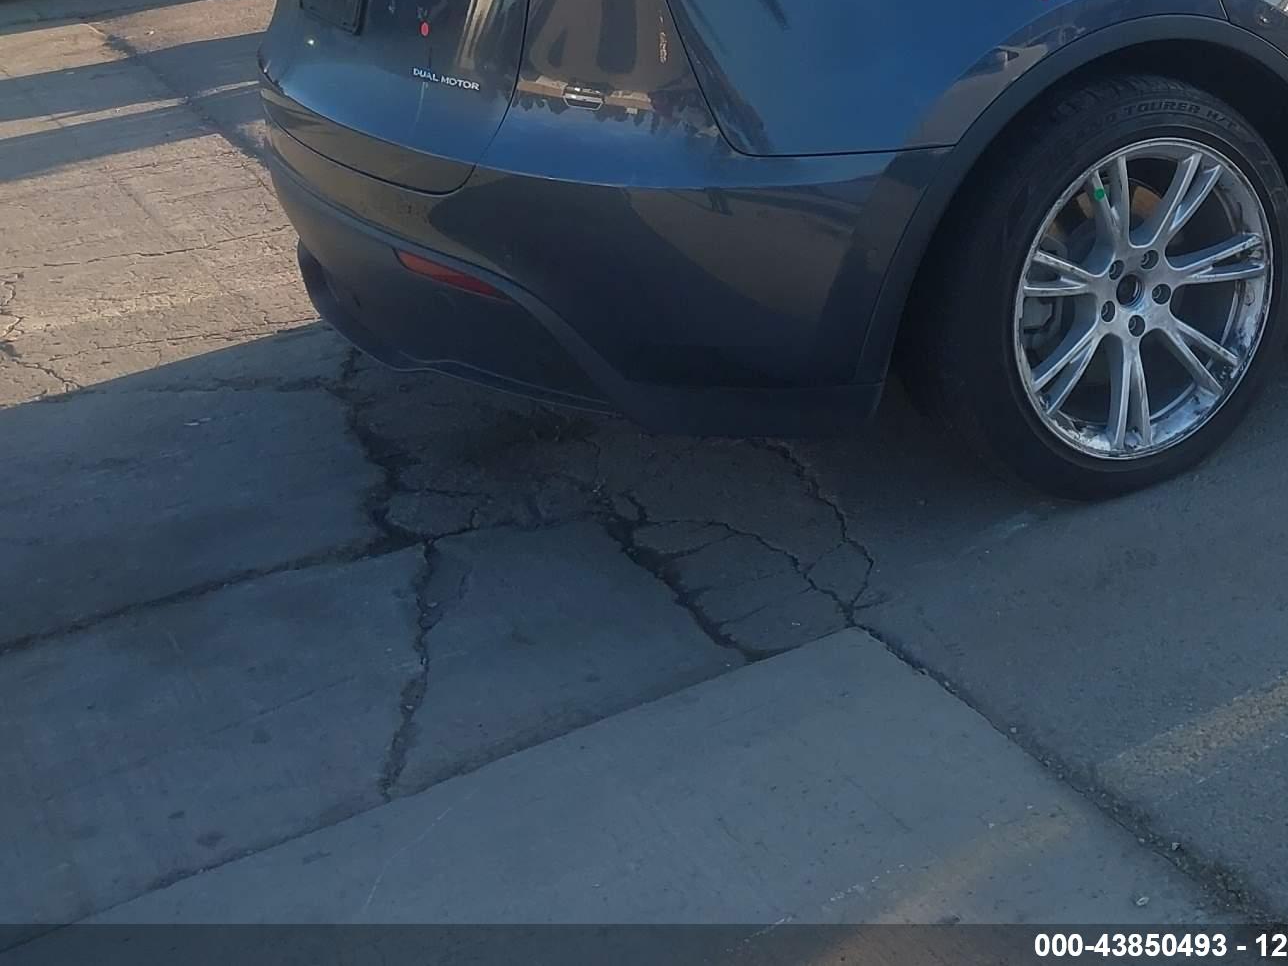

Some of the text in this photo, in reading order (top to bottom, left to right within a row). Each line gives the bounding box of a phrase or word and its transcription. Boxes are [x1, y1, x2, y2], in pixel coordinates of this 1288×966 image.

[413, 68, 480, 91] DUAL MOTOR
[1122, 100, 1200, 116] TOURER
